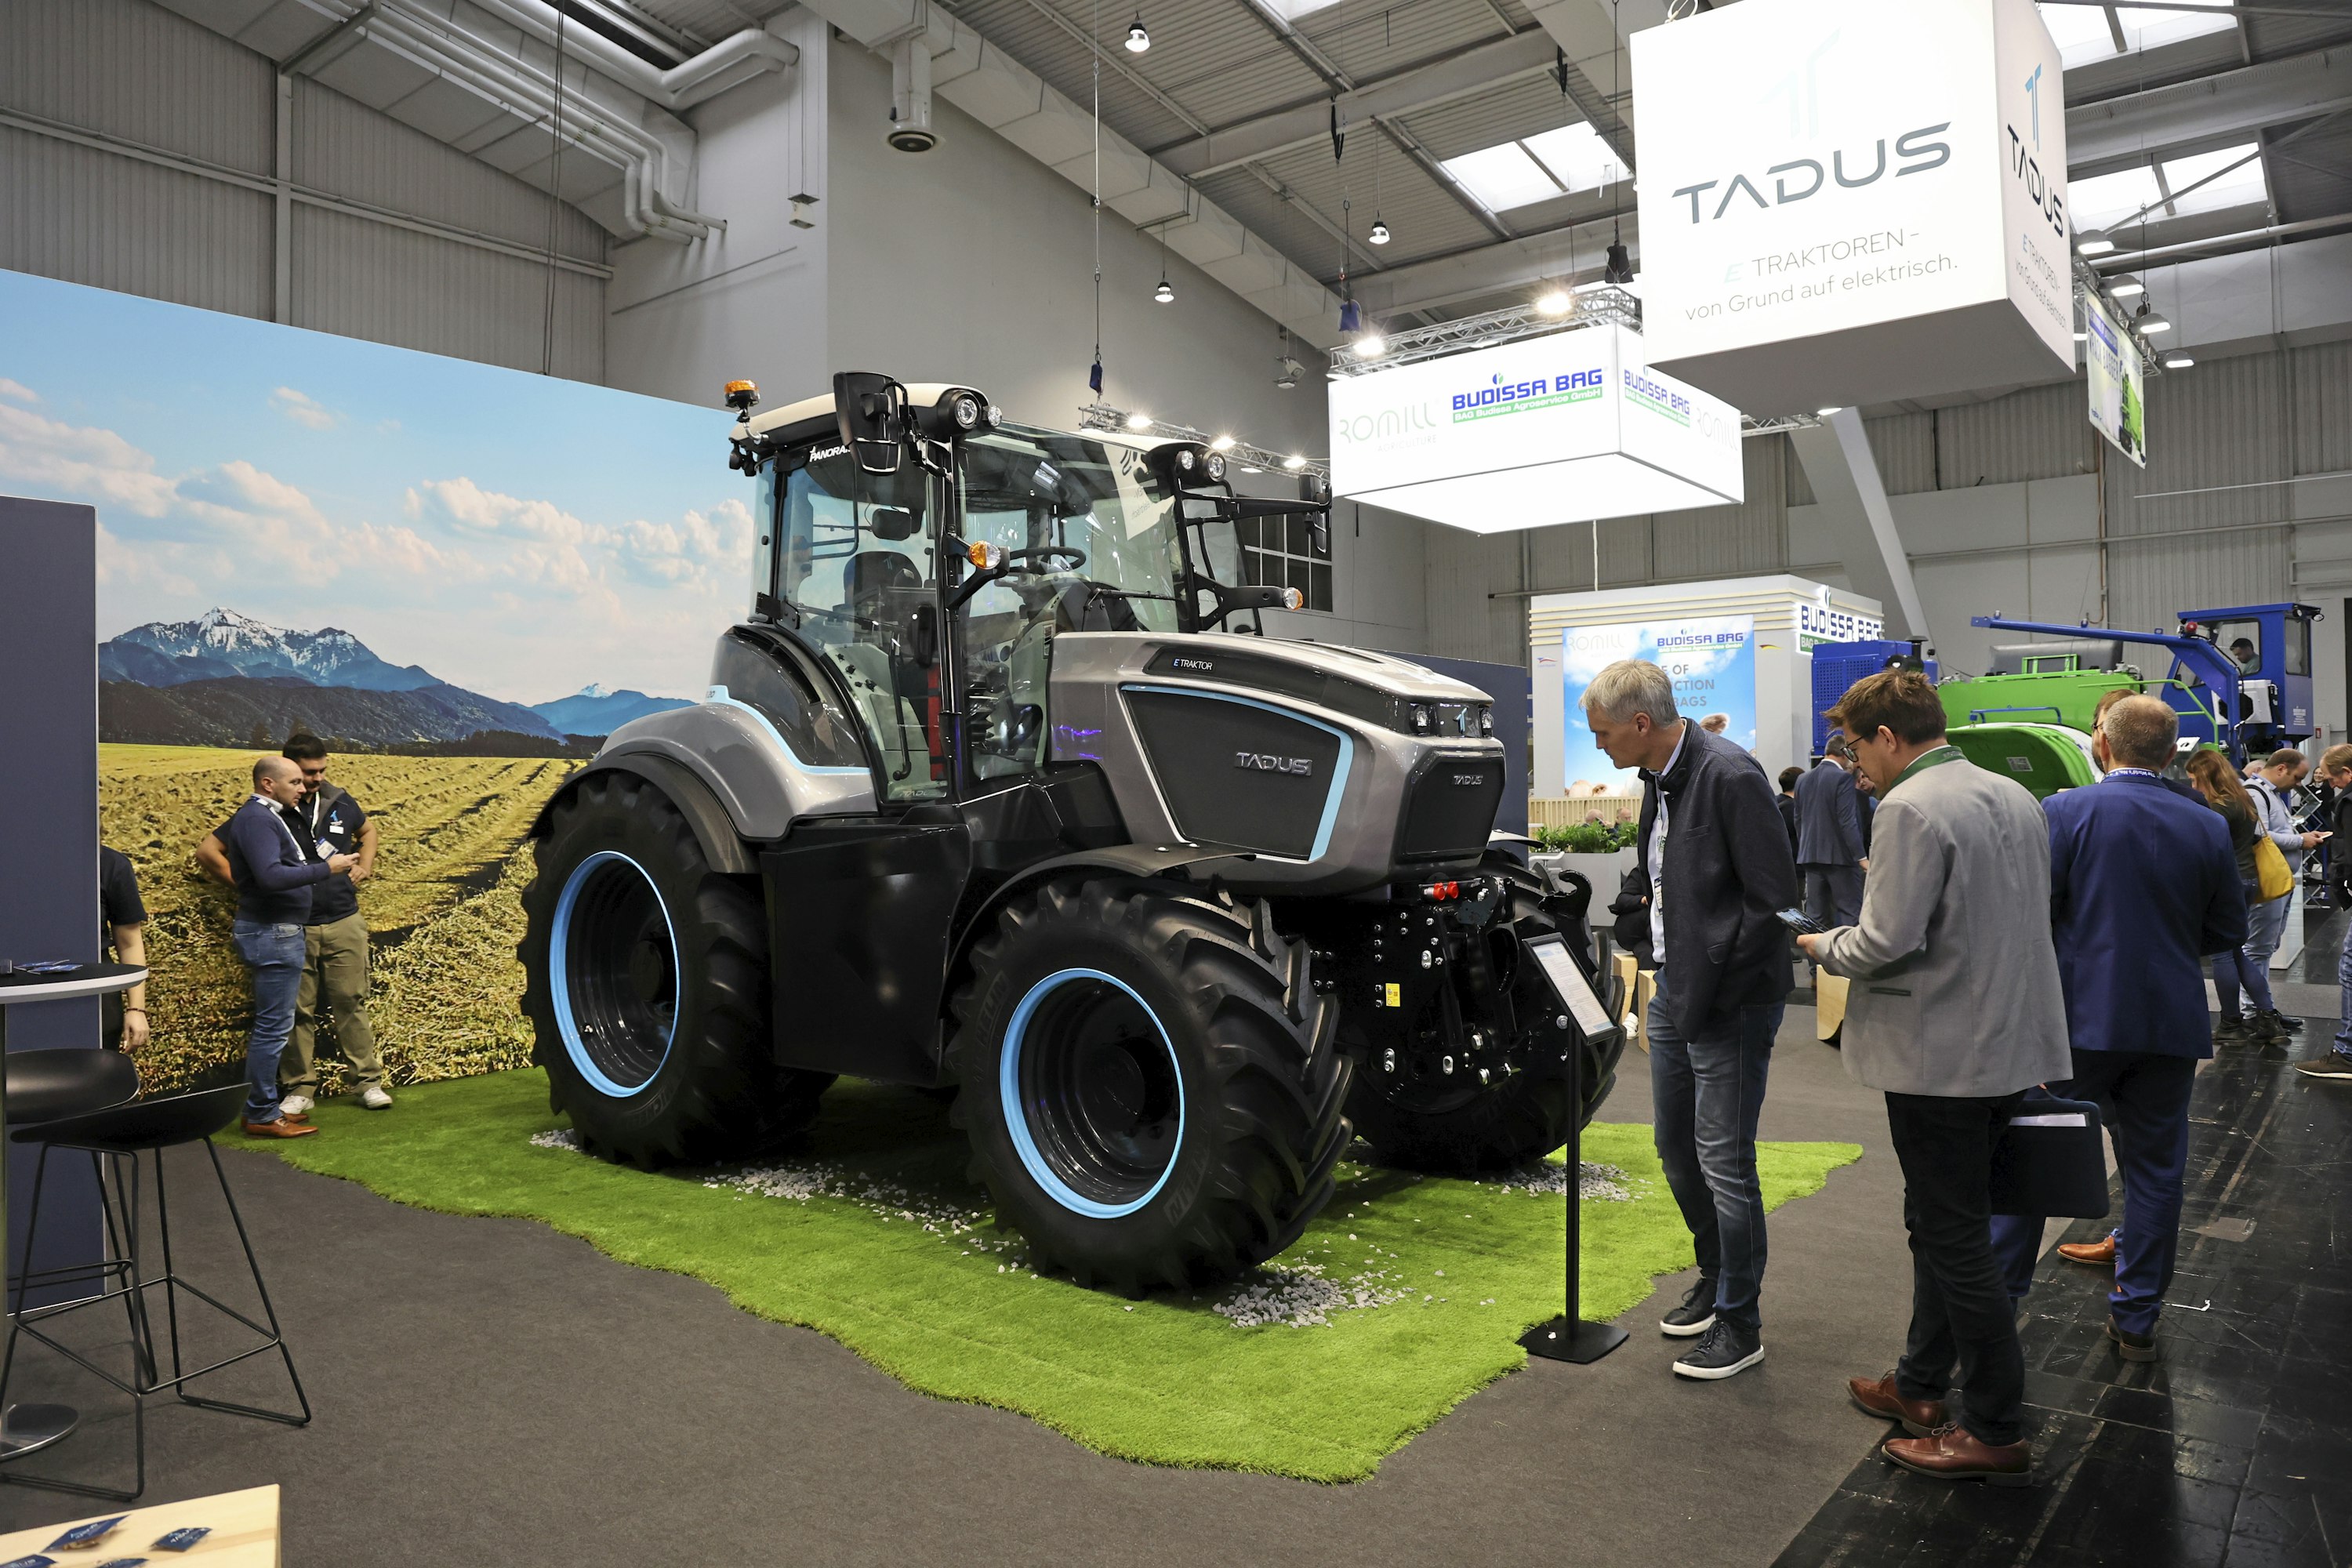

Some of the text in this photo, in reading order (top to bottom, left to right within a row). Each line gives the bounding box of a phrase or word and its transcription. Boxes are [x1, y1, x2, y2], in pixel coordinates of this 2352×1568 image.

[1672, 122, 1951, 224] TADUS
[2007, 123, 2063, 238] TADUS
[1751, 228, 1904, 277] TRAKTOREN
[1686, 253, 1958, 321] von Grund auf elektrisch.
[1453, 368, 1602, 411] BUDISSA BAG
[1454, 388, 1601, 422] BAG Budissa Agroservice GmbH
[1624, 369, 1690, 416] BUDISSA BAG
[809, 445, 851, 463] PANORA
[1801, 604, 1854, 641] BUDISSA
[1657, 633, 1744, 647] BUDISSA BAG
[1180, 659, 1213, 670] TRAKTOR
[1672, 664, 1689, 675] OF
[1671, 679, 1715, 691] CTION
[1236, 752, 1313, 775] TADUS
[1454, 775, 1483, 785] TADUS
